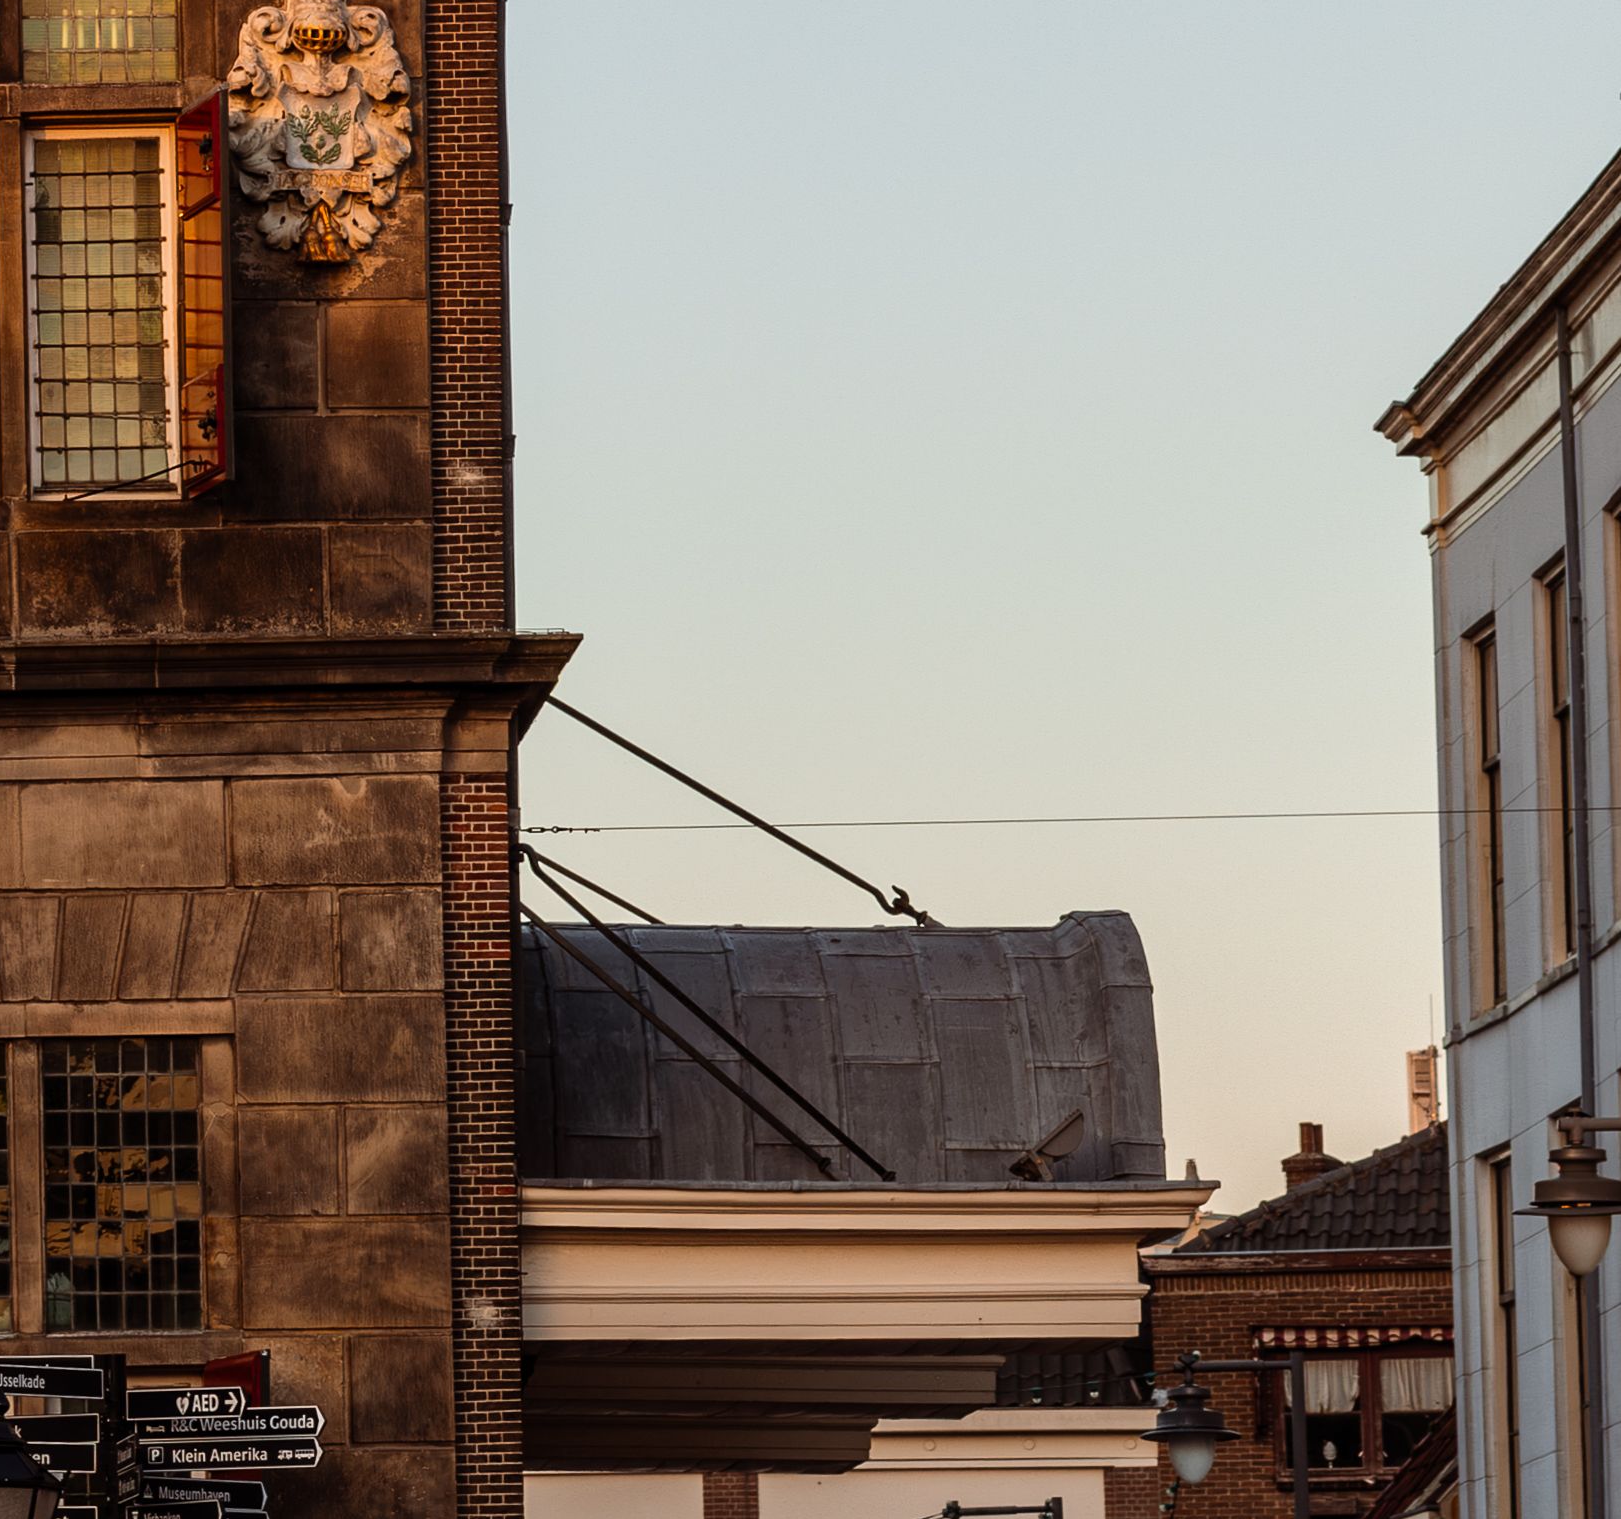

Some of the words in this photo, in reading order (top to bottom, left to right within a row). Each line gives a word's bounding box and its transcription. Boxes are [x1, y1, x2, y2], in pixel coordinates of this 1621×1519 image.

[192, 1394, 220, 1412] AED
[170, 1418, 198, 1433] R&C
[200, 1416, 267, 1432] Weeshuis
[269, 1414, 314, 1430] Gouda
[172, 1449, 207, 1464] Klein
[210, 1447, 268, 1463] Amerika
[158, 1486, 231, 1503] Museumhaven
